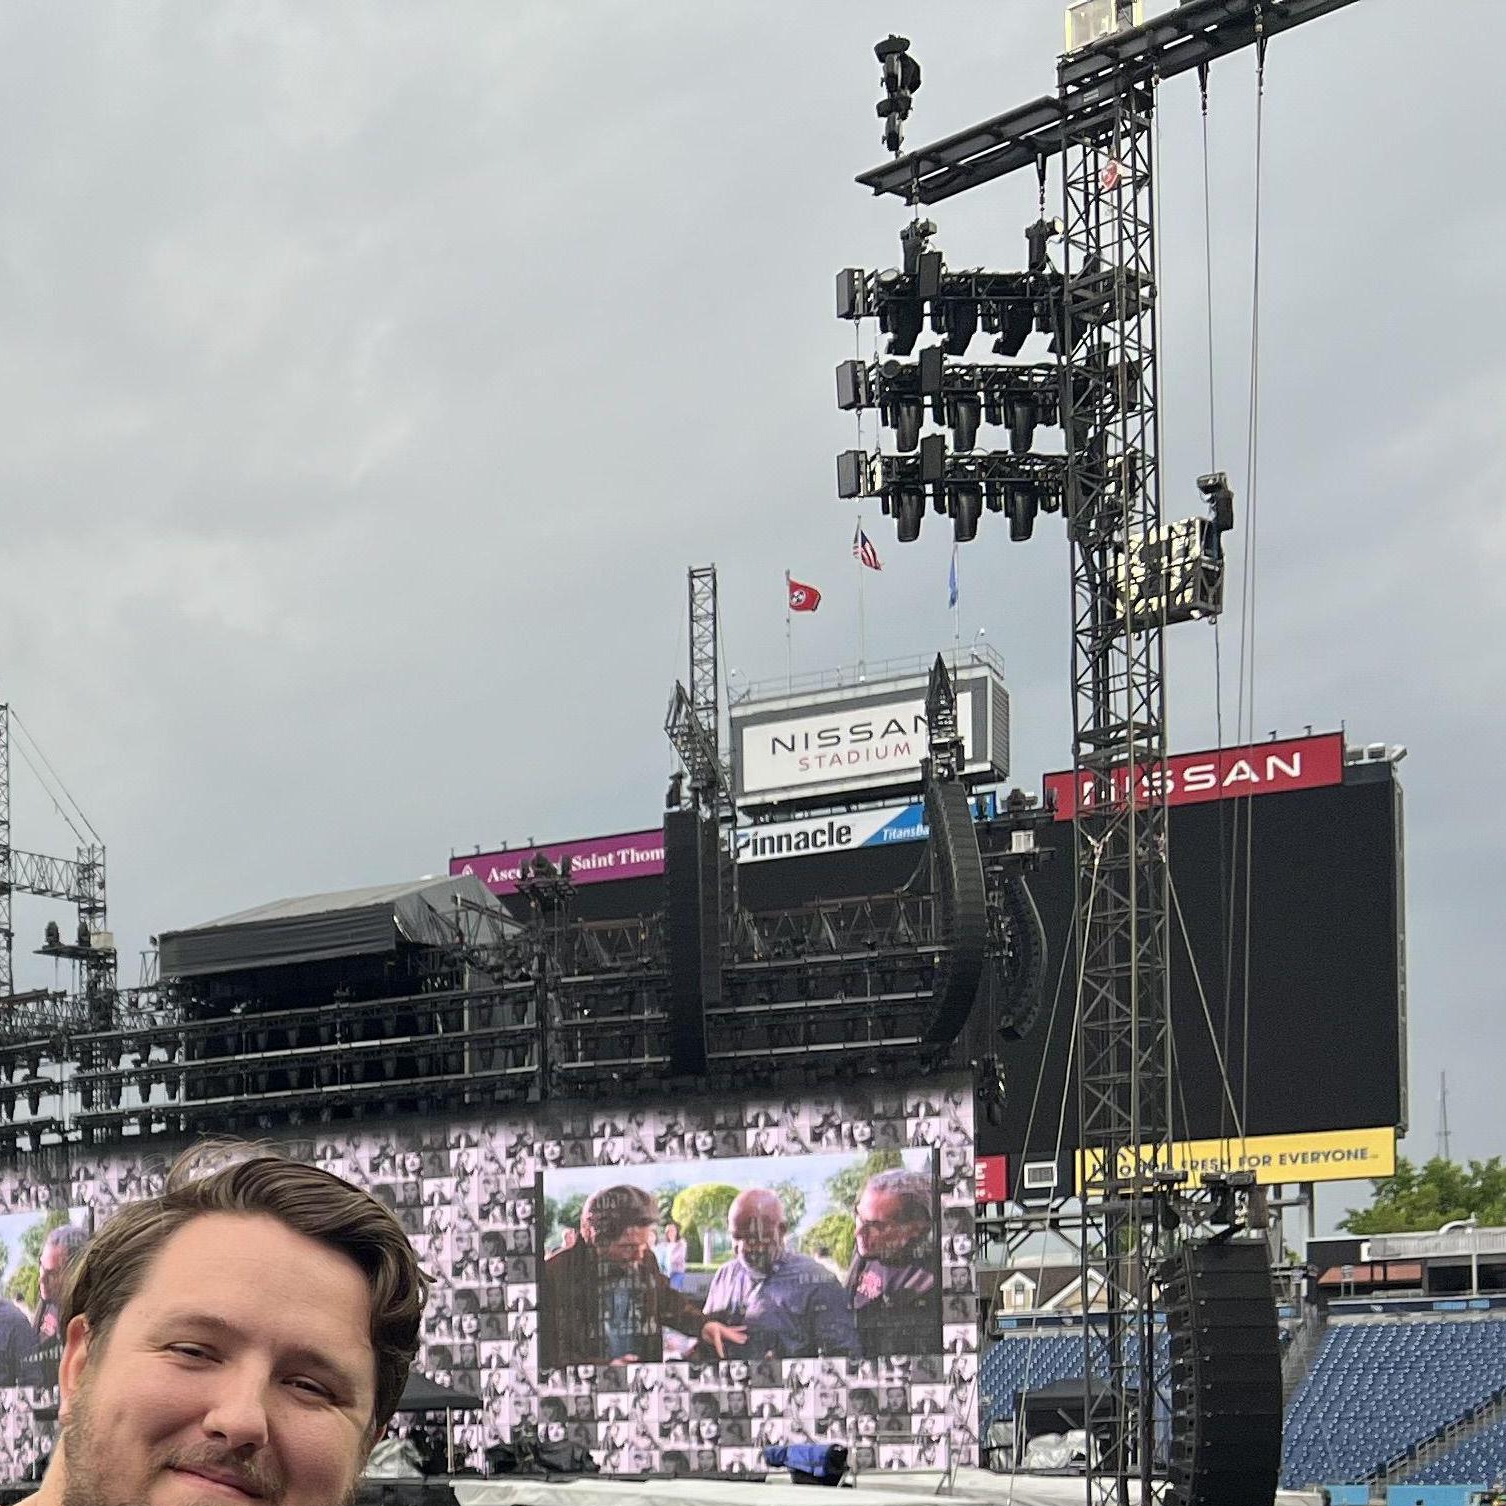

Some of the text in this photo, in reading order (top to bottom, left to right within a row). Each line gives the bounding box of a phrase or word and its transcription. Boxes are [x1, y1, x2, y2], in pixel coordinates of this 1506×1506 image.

[798, 741, 911, 772] STADIUM
[737, 820, 852, 857] Pinnacle
[571, 852, 615, 872] Saint
[1238, 1154, 1273, 1168] FOR
[1279, 1147, 1370, 1166] EVERYONE
